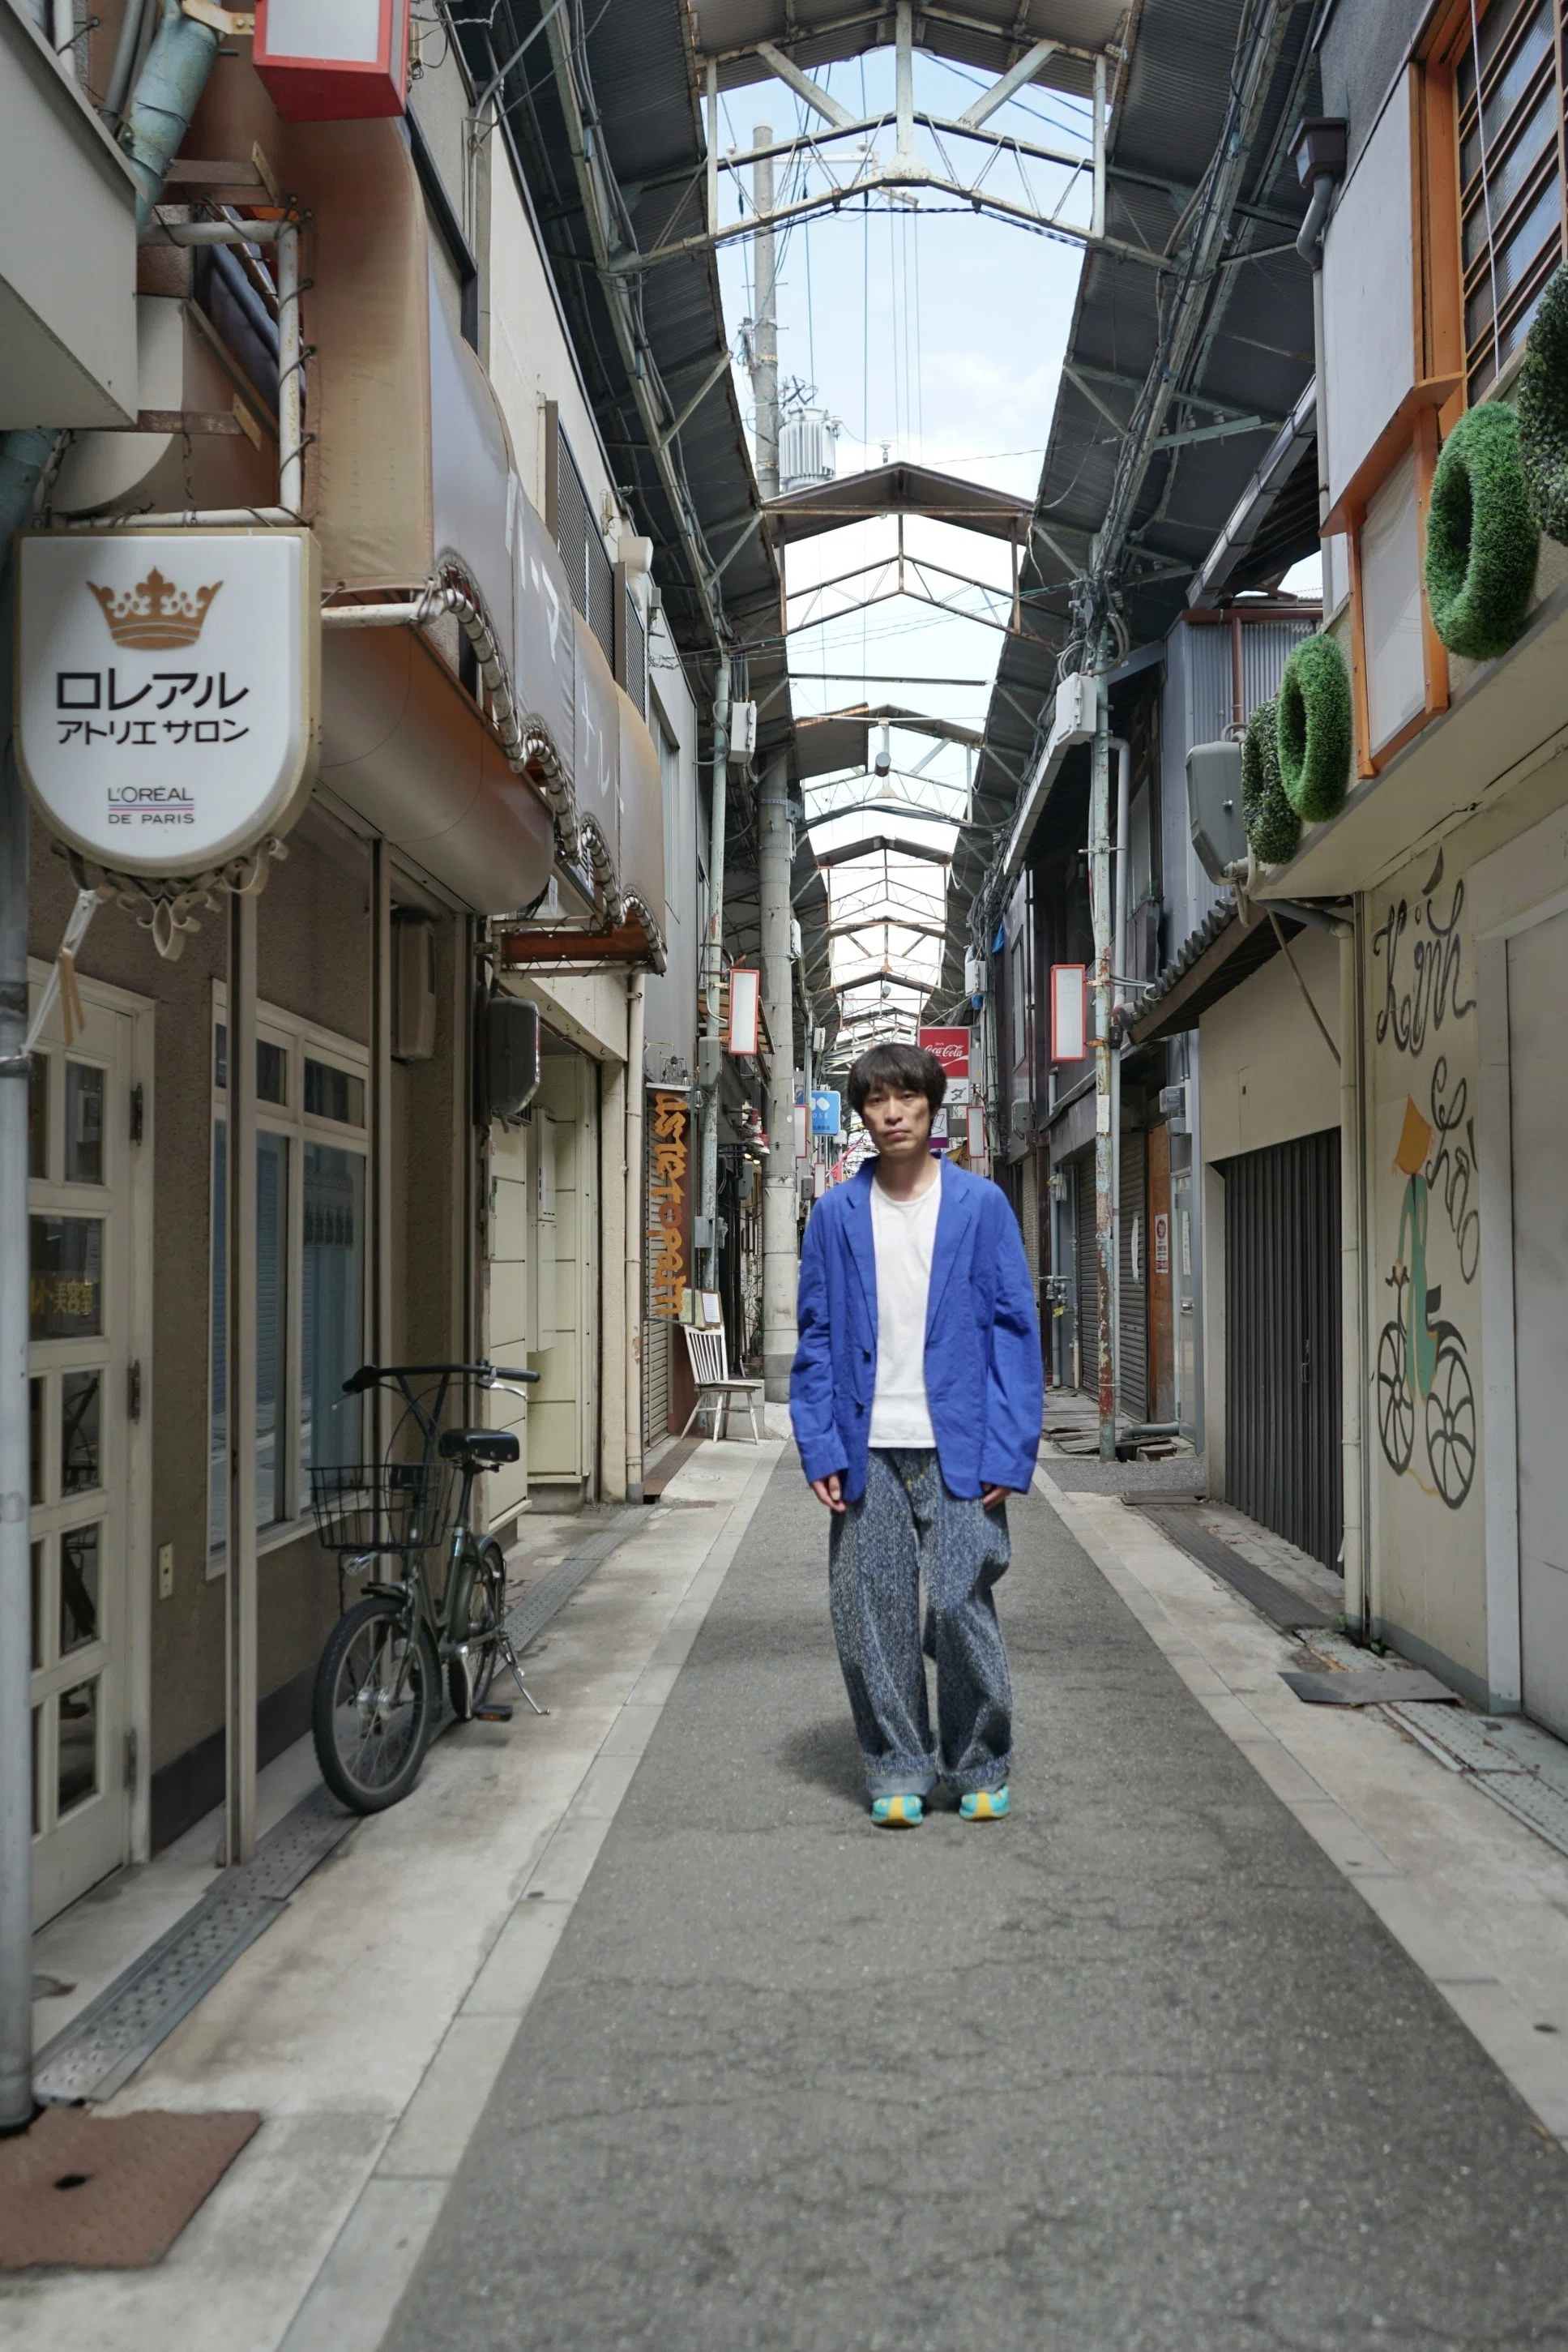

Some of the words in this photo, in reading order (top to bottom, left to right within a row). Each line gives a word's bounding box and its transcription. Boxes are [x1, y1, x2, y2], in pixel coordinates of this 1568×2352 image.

[56, 667, 250, 711] ロレアル
[108, 786, 194, 802] L'ORÉAL
[108, 813, 131, 824] DE
[141, 813, 195, 825] PARIS
